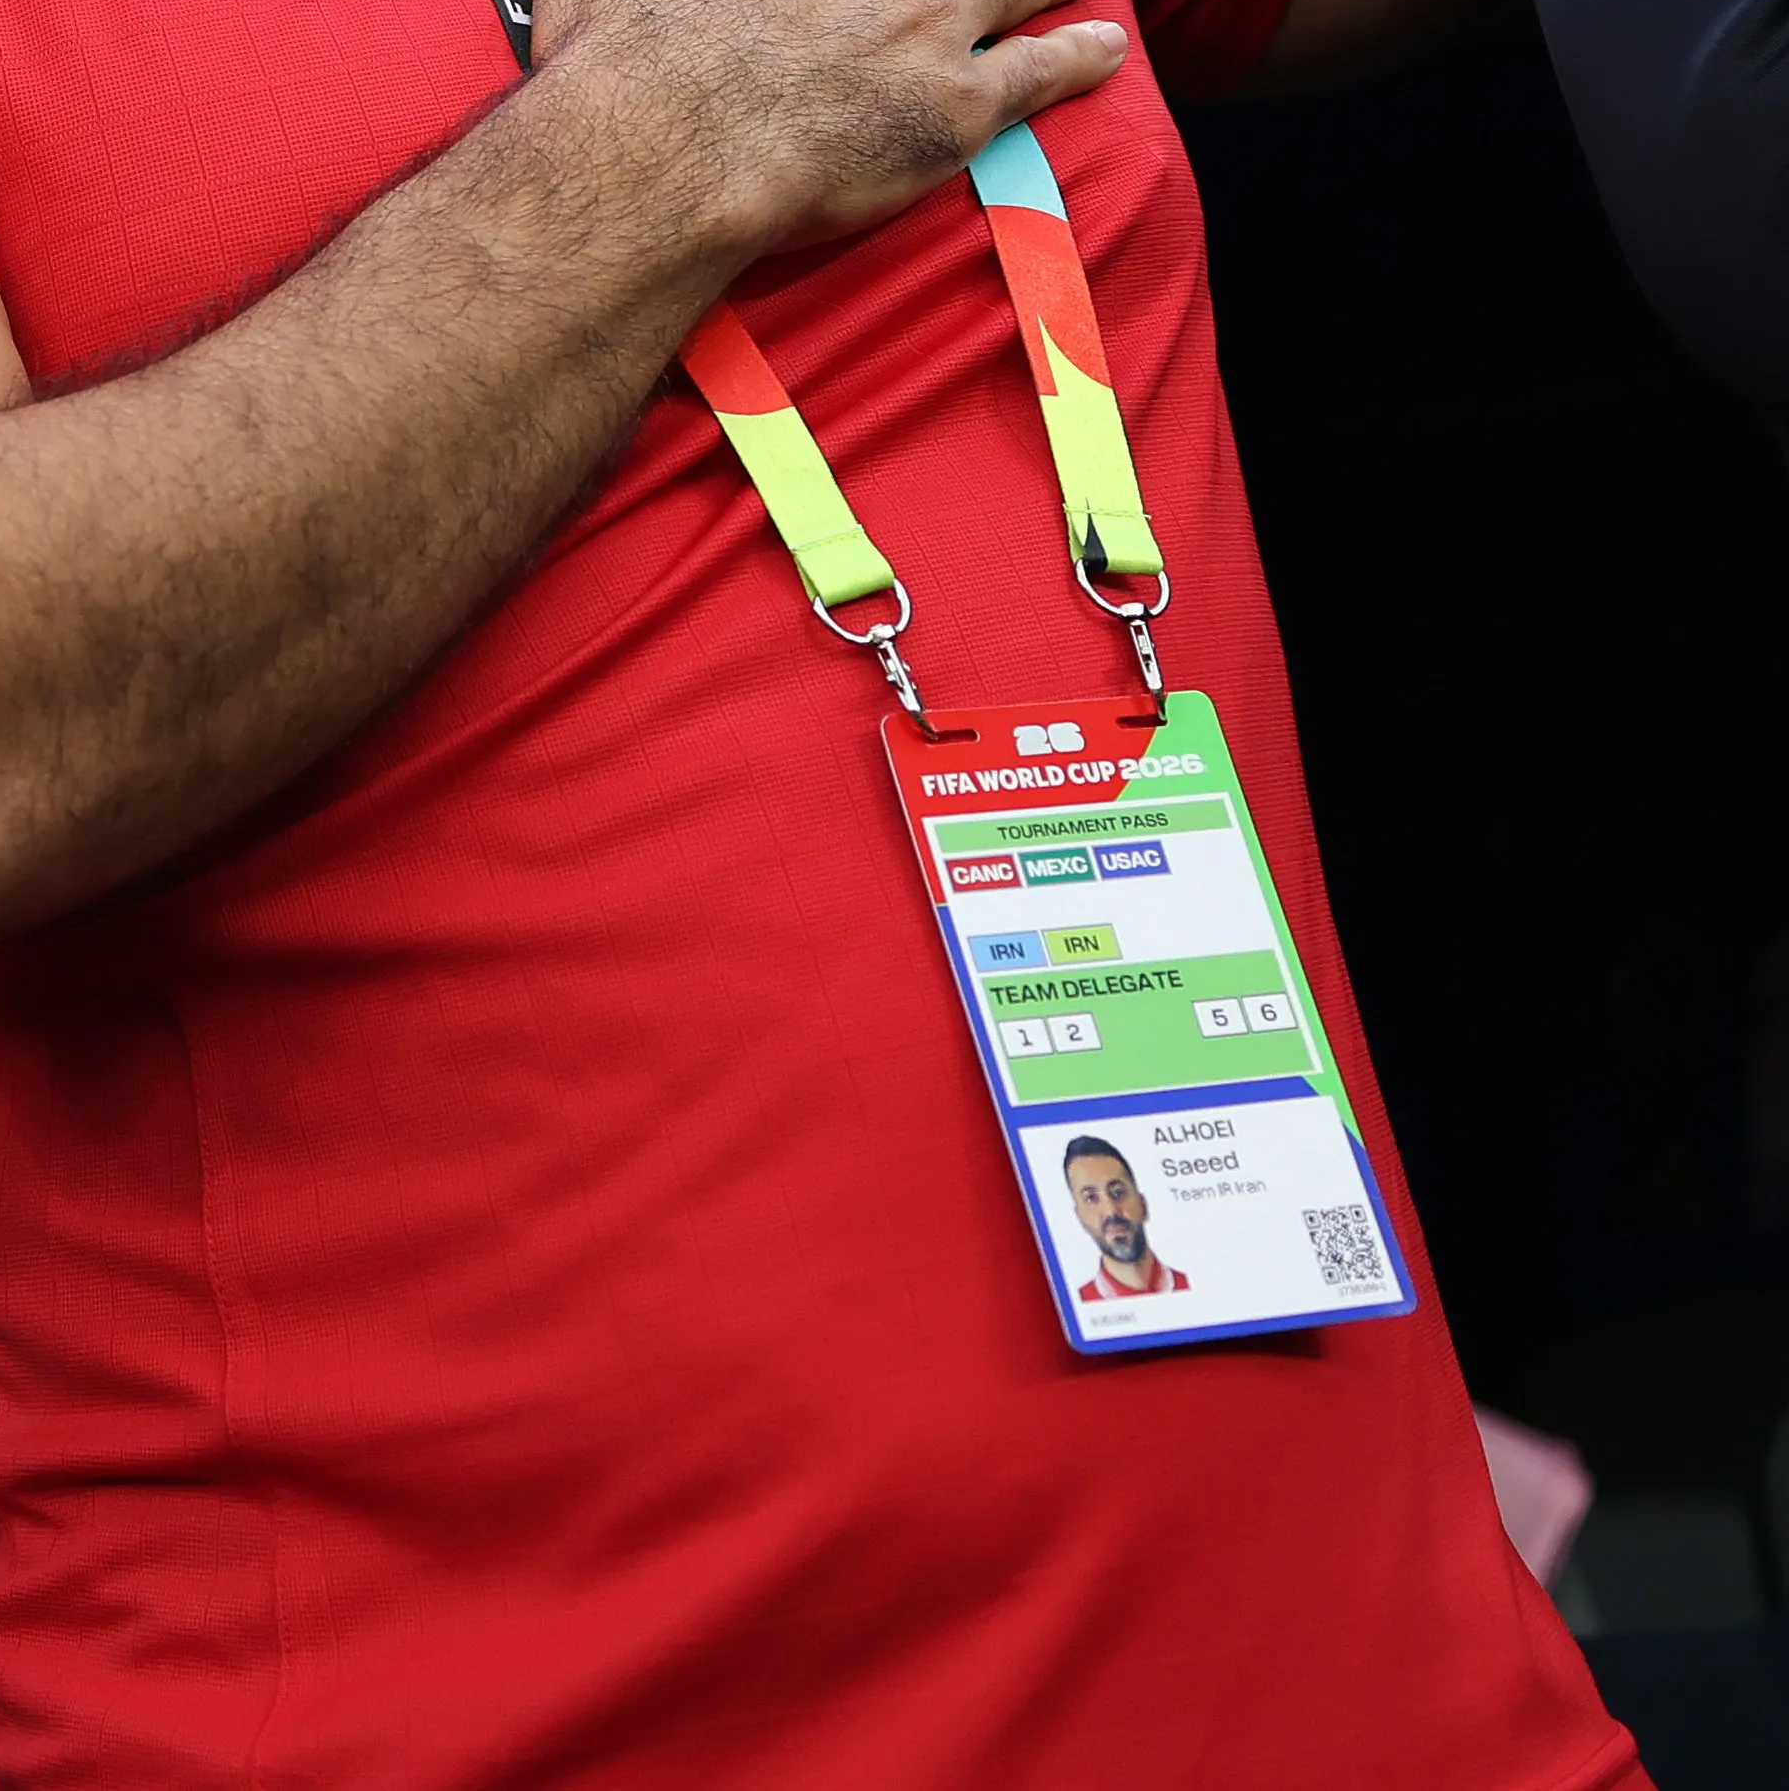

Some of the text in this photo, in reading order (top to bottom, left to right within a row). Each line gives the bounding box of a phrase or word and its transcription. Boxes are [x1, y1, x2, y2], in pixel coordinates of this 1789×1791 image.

[921, 753, 1205, 798] FIFA WORLD CUP 2026
[997, 812, 1170, 841] TOURNAMENT PASS
[1025, 855, 1089, 878] MEXC
[1101, 849, 1162, 871] USAC
[952, 862, 1015, 886] CANC
[989, 941, 1026, 961] IRN
[1064, 934, 1101, 954] IRN
[989, 969, 1184, 1006] TEAM DELEGATE
[1212, 1008, 1229, 1027] 5
[1261, 1003, 1278, 1022] 6
[1017, 1028, 1034, 1047] 1
[1068, 1023, 1083, 1042] 2
[1153, 1119, 1236, 1146] ALHOEI
[1161, 1150, 1241, 1177] Saeed
[1169, 1185, 1217, 1202] Team
[1234, 1179, 1268, 1195] Iran
